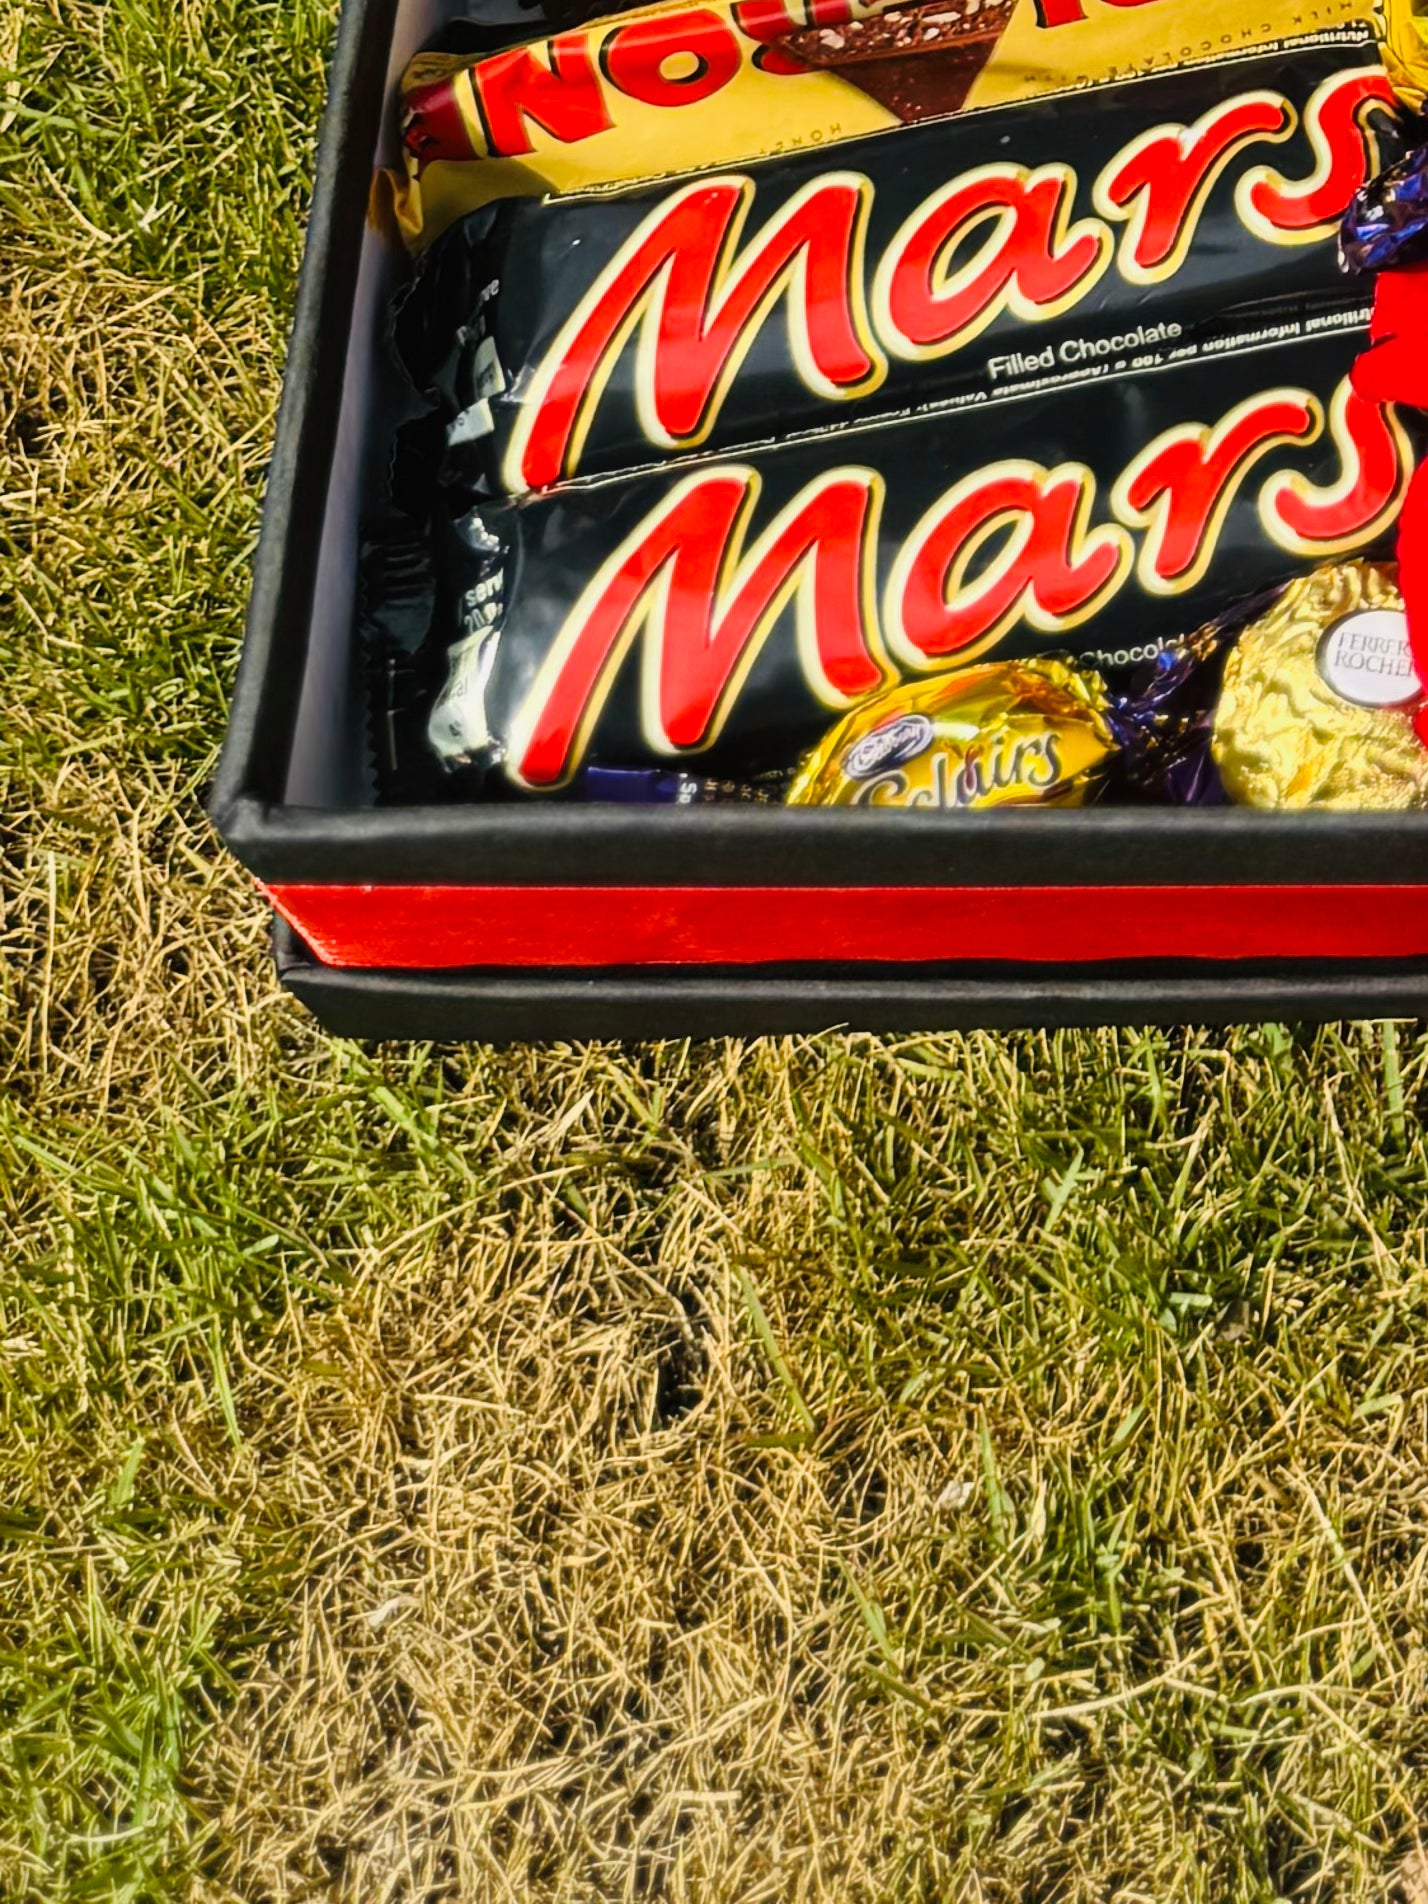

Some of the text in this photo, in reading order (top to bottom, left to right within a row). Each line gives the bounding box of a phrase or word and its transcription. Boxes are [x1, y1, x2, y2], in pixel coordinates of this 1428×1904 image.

[503, 63, 1398, 492] Mars
[1305, 306, 1375, 334] tritional
[987, 319, 1183, 382] Filled Chocolate
[508, 377, 1411, 789] Mars
[1333, 649, 1415, 678] ROCHE
[1336, 631, 1412, 658] FERRER
